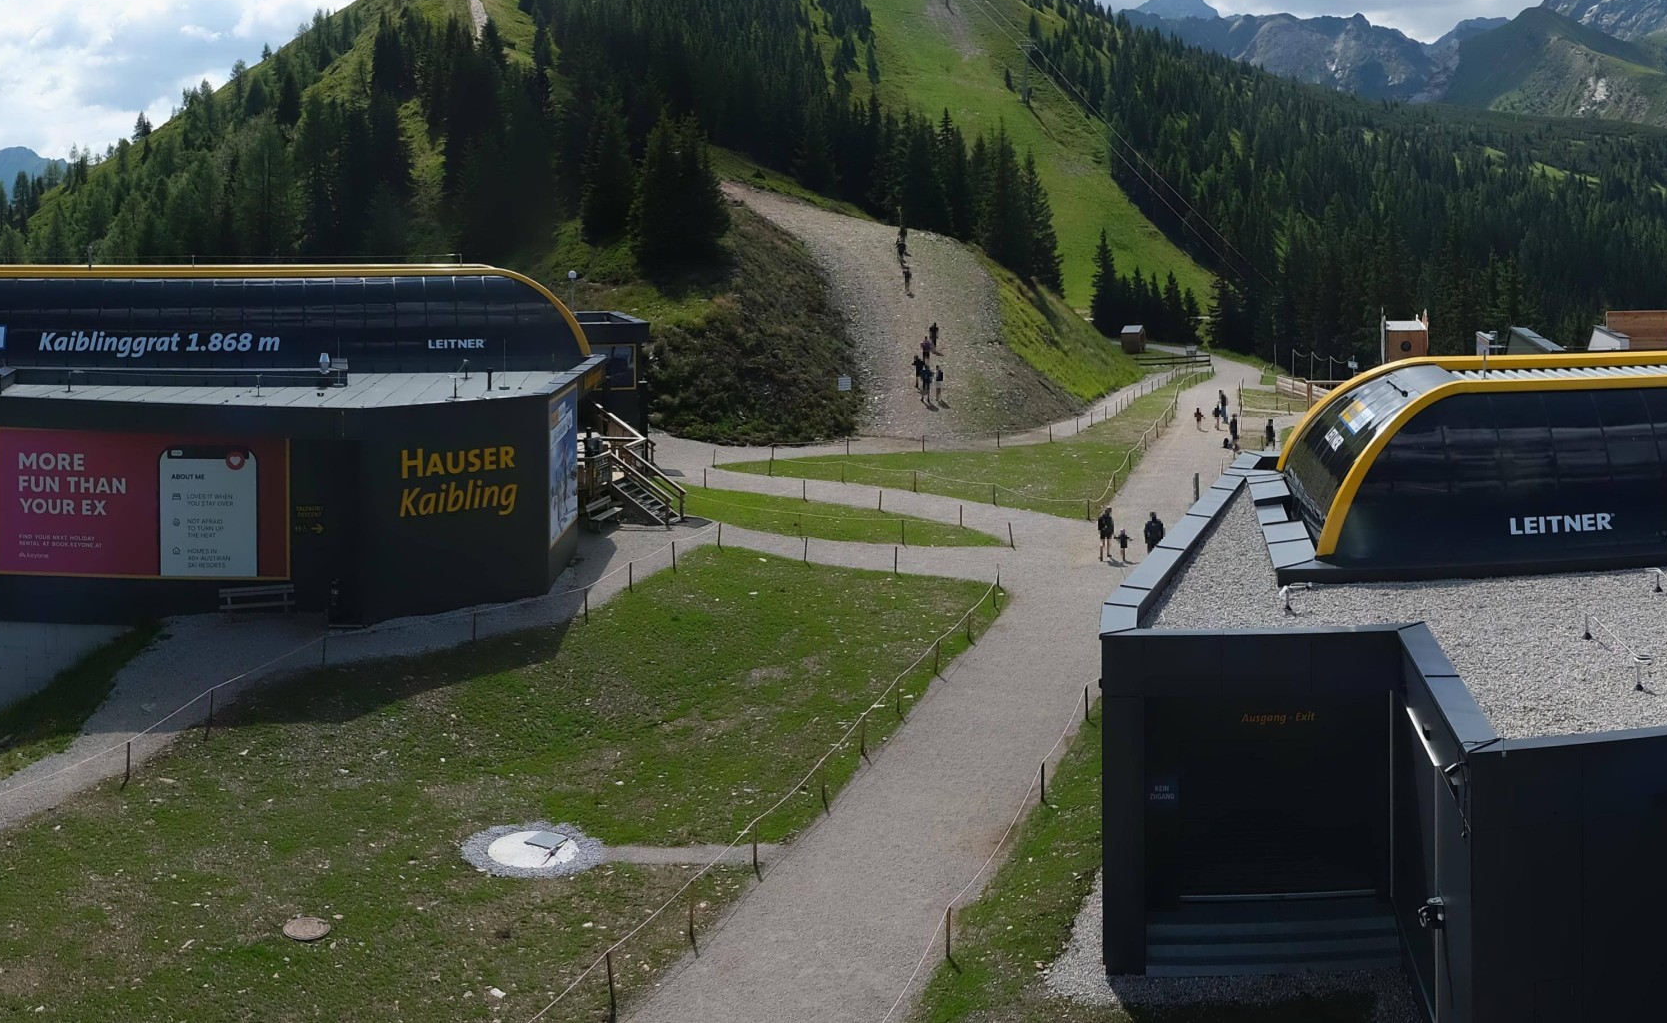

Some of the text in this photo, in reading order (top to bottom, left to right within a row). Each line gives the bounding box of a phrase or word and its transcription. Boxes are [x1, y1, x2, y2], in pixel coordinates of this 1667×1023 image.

[38, 331, 280, 358] Kaiblinggrat 1.868 m
[428, 338, 486, 350] LEITNER
[18, 452, 84, 471] MORE
[401, 446, 516, 479] HAUSER
[18, 476, 126, 494] FUN THAN
[20, 498, 106, 516] YOUR EX
[400, 480, 518, 518] Kaibling
[1510, 512, 1613, 535] LEITNER
[1241, 712, 1287, 725] Ausgang
[1295, 711, 1316, 721] Exit
